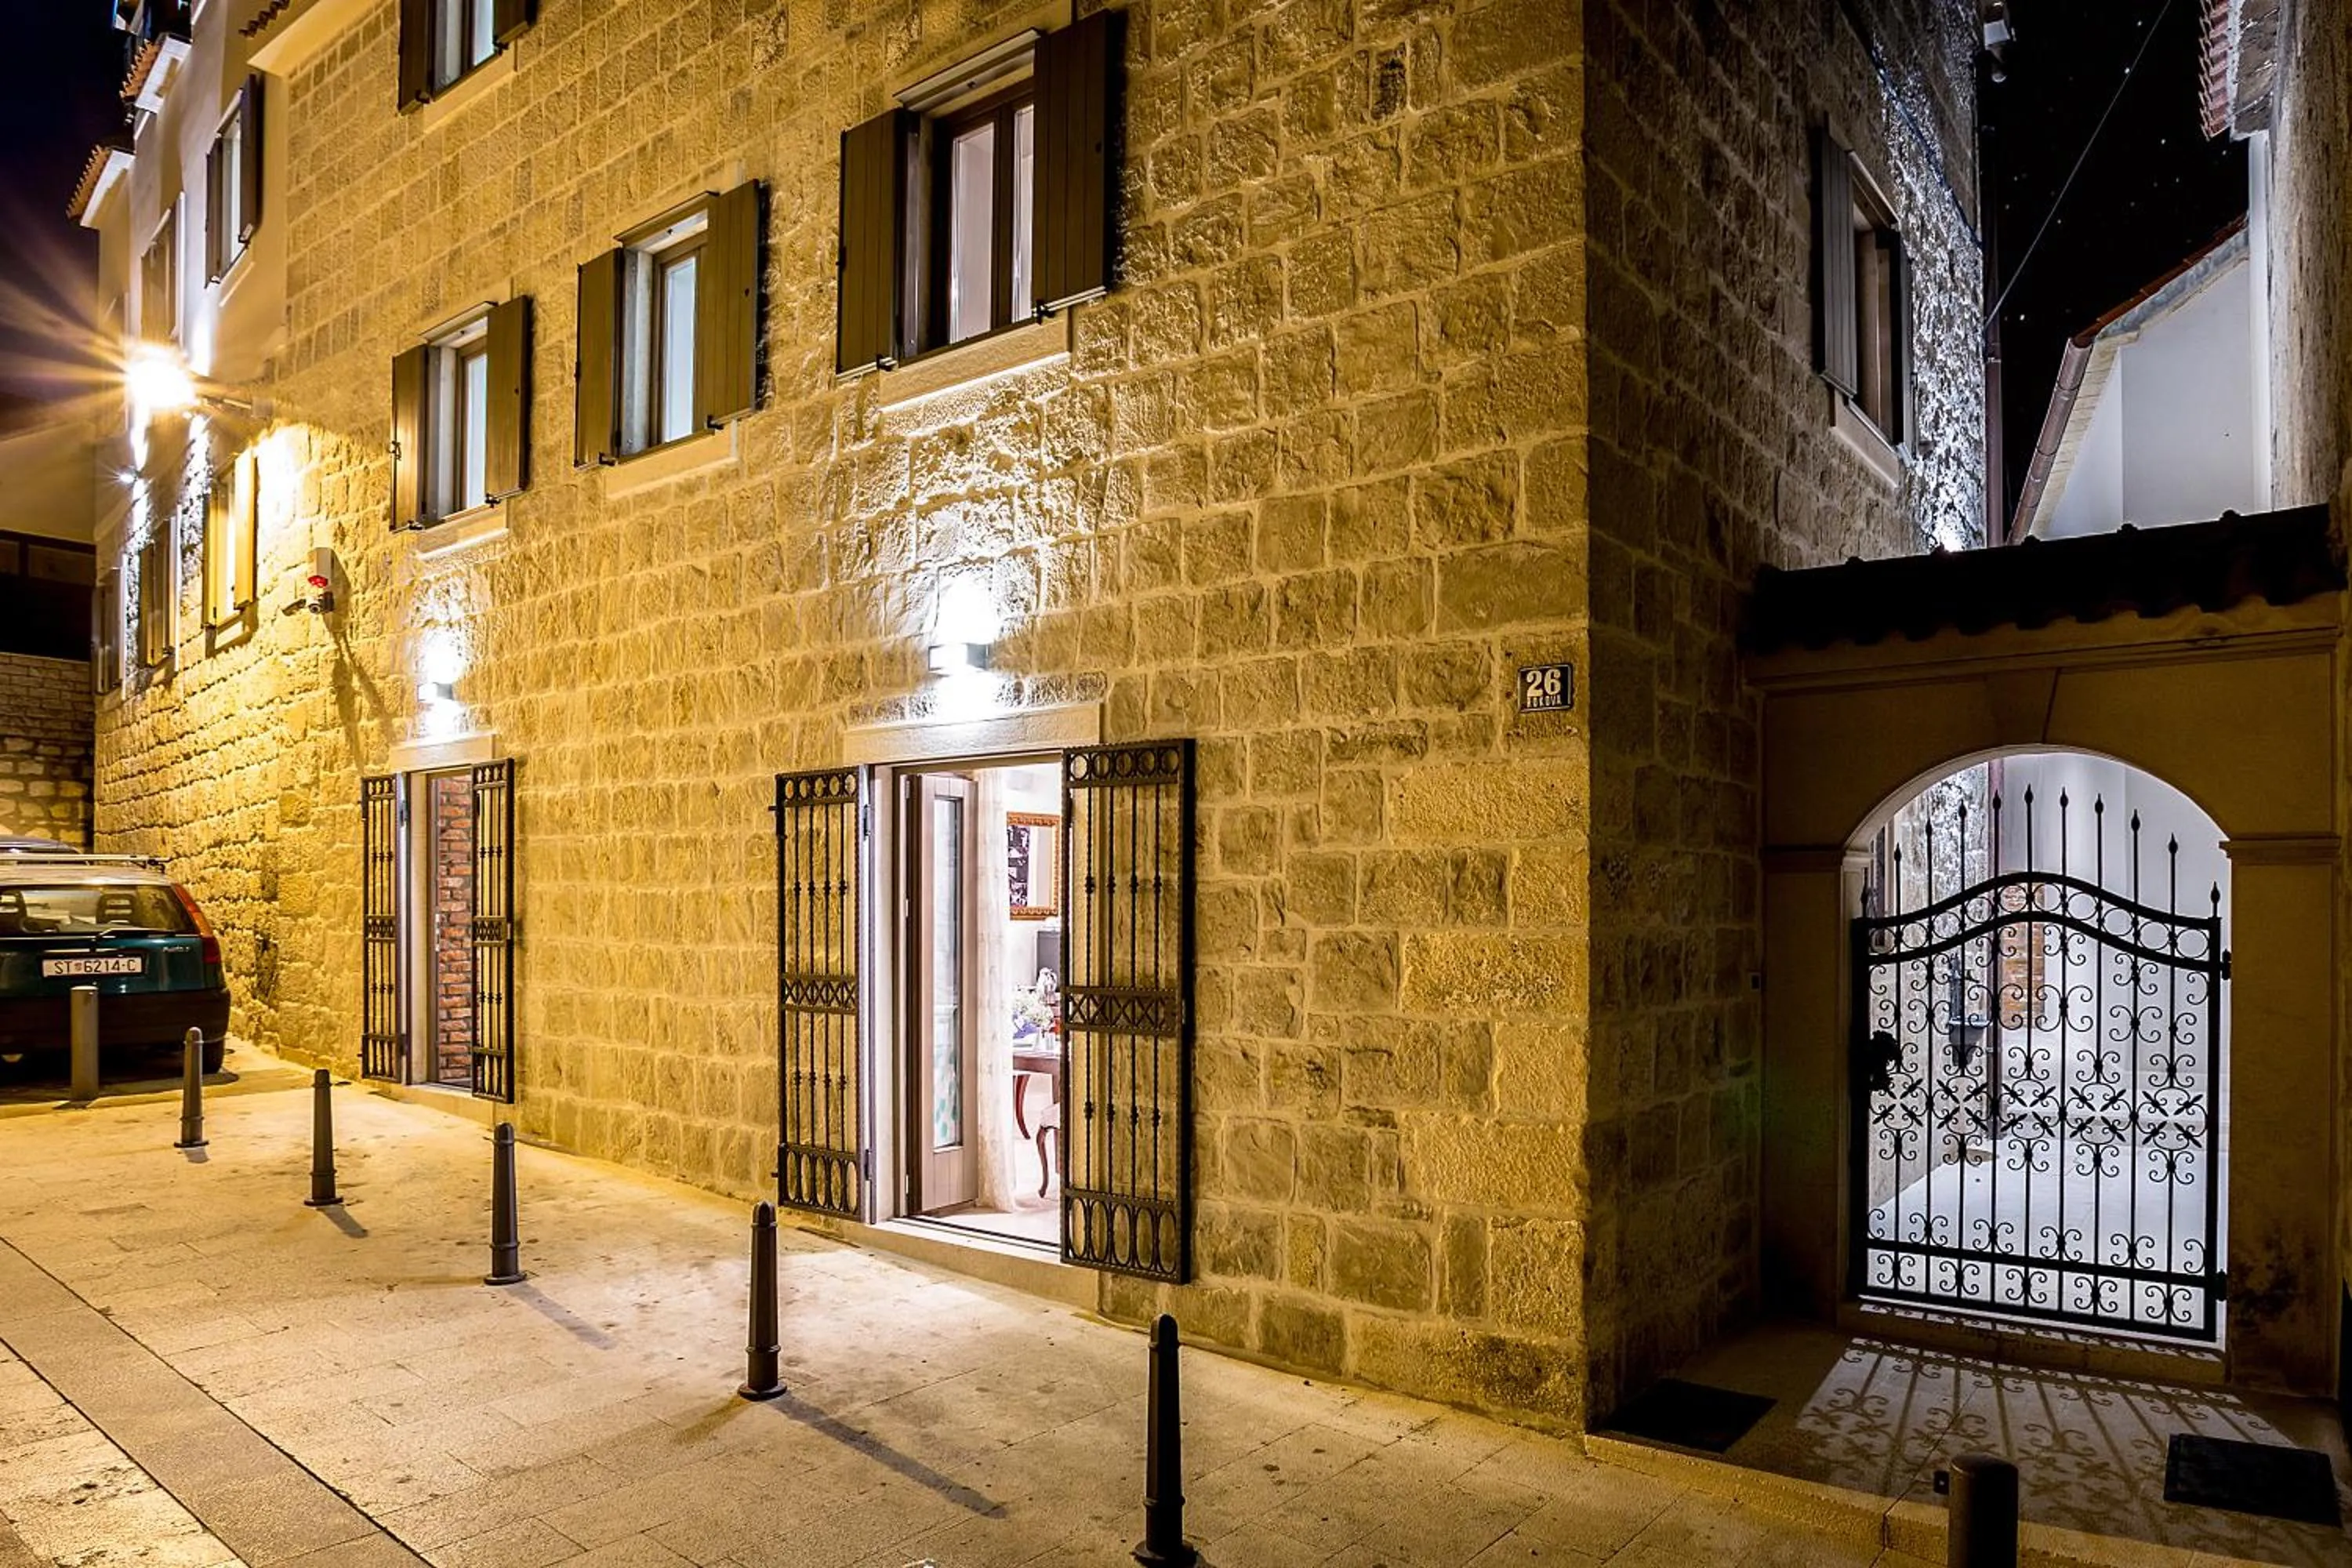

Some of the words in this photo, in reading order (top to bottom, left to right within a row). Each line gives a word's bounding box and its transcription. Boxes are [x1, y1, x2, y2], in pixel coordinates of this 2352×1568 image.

[1526, 669, 1561, 697] 26
[54, 961, 72, 975] ST
[83, 959, 136, 973] 6214-C
